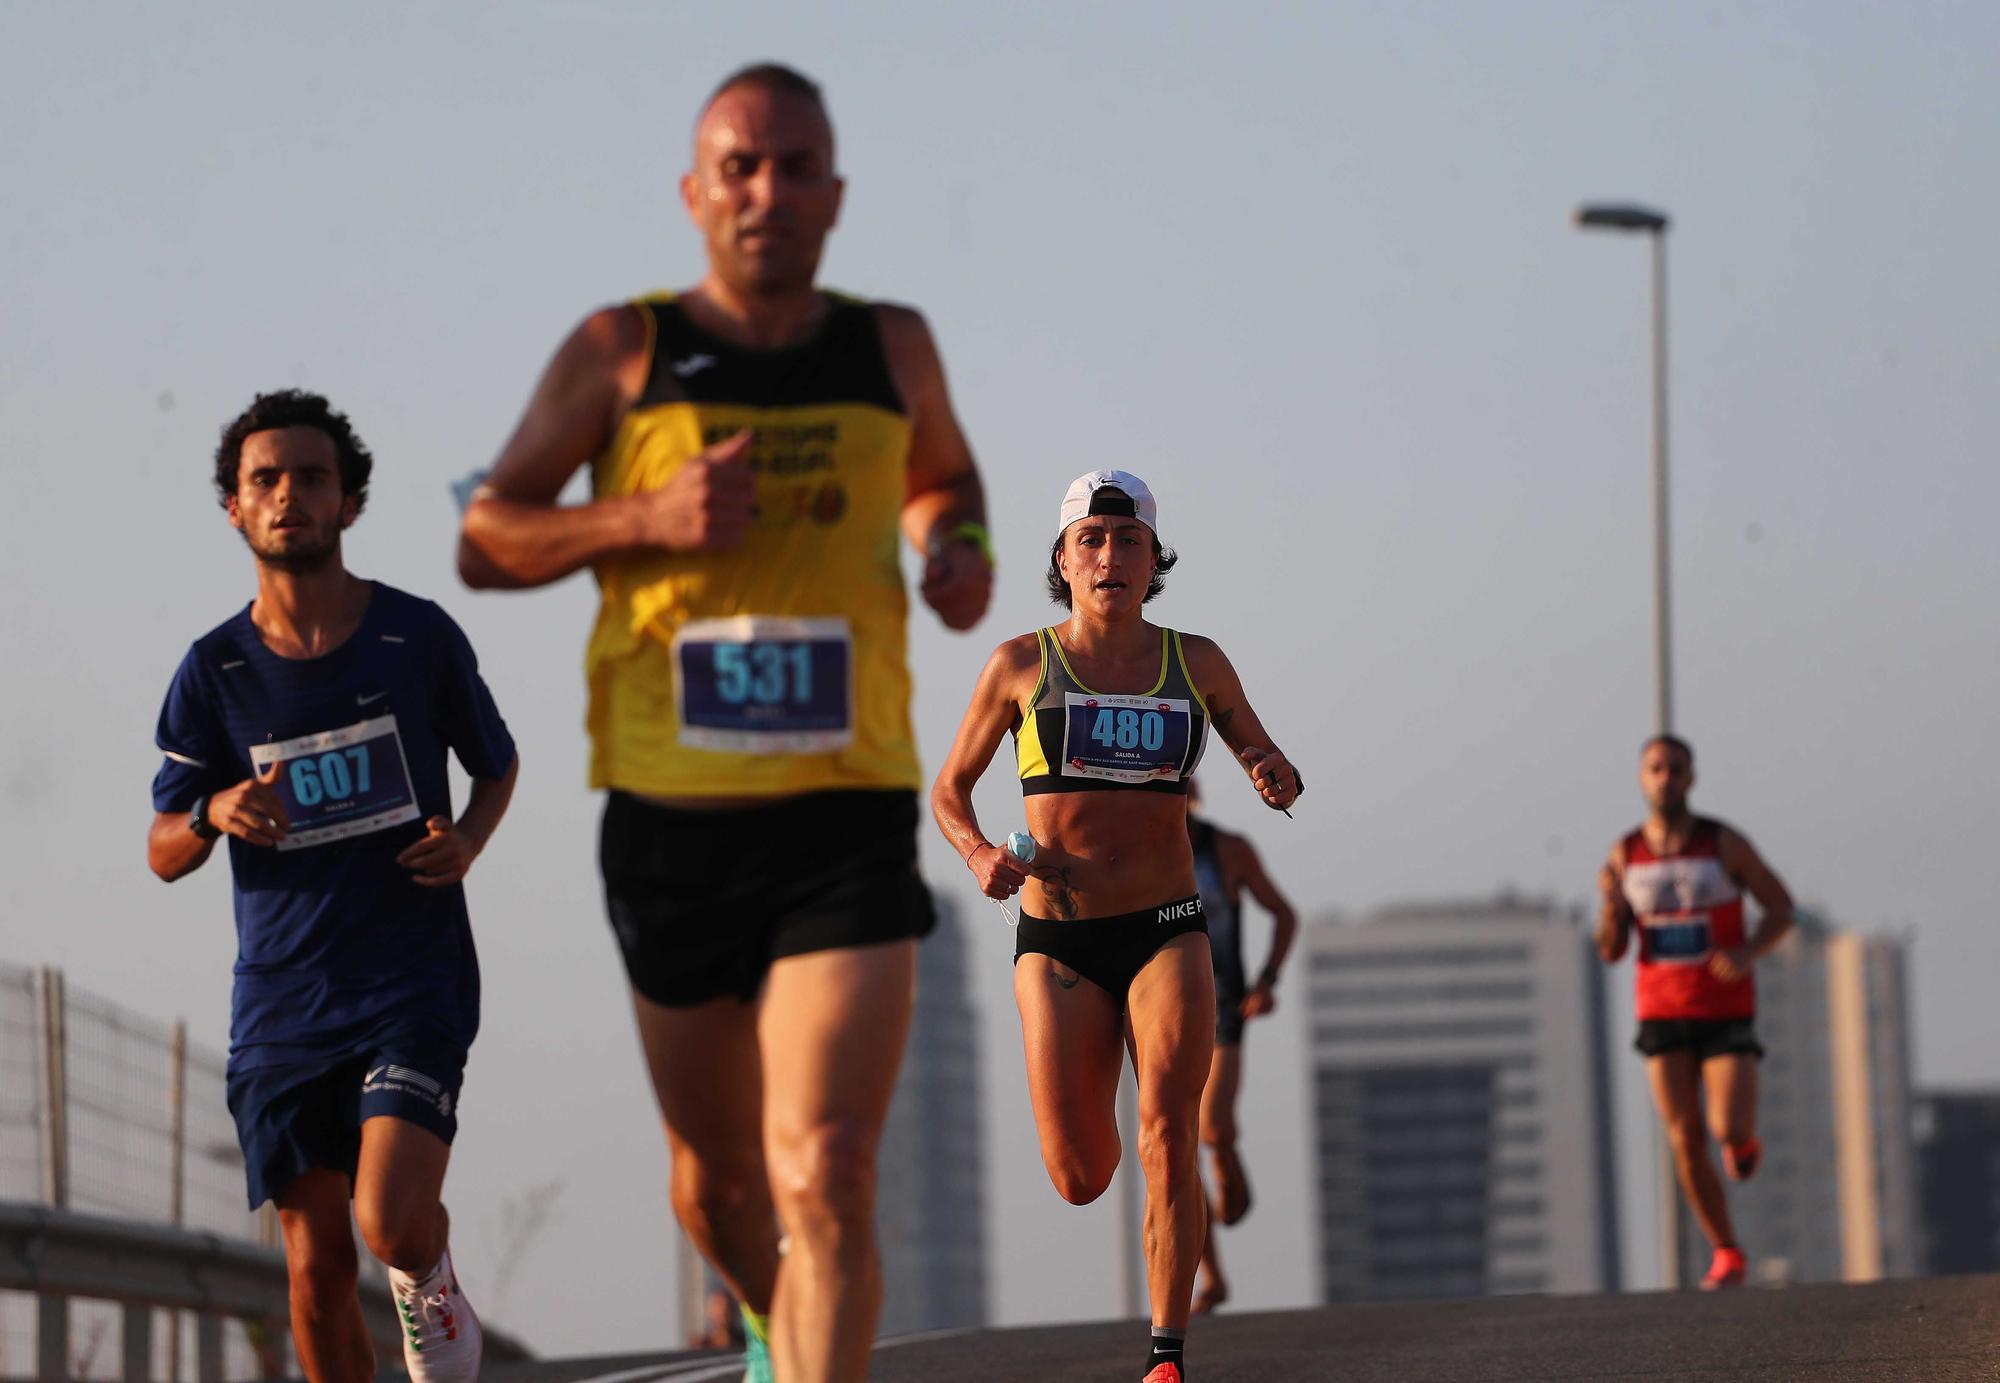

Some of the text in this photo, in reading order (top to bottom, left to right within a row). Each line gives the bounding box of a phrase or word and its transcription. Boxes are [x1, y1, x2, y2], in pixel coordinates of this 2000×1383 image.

[713, 642, 812, 704] 531
[1092, 709, 1164, 751] 480
[289, 745, 370, 806] 607
[1114, 751, 1136, 759] SALIDA
[1158, 901, 1196, 923] NIKE
